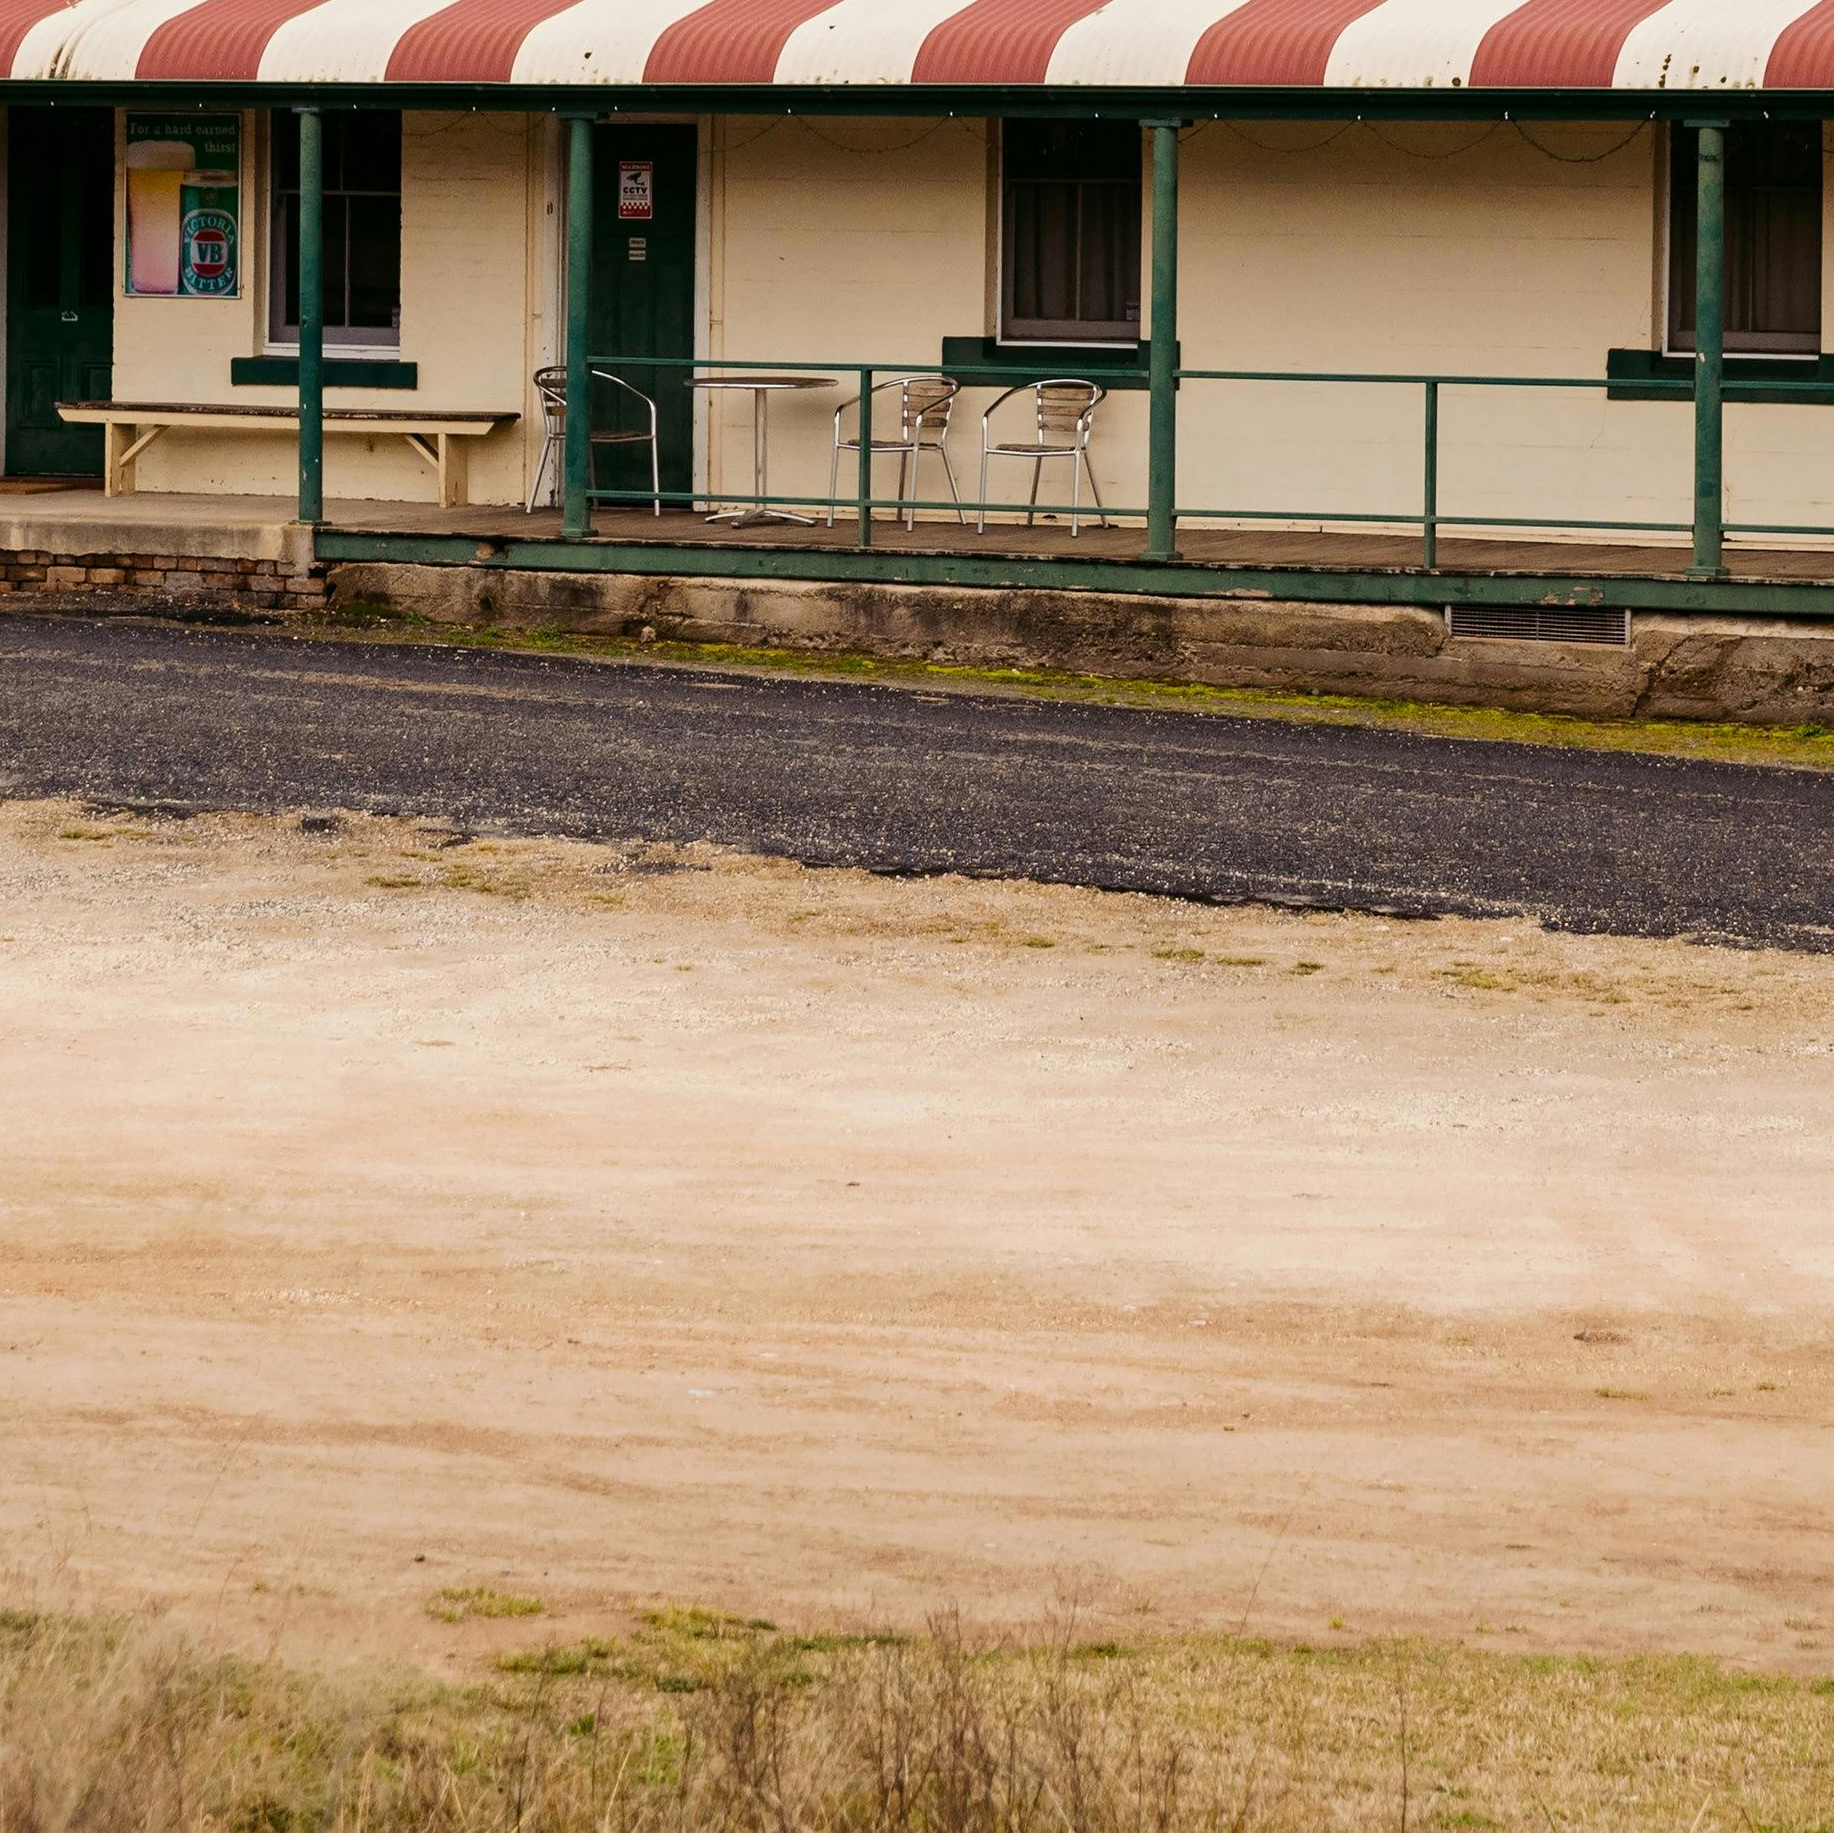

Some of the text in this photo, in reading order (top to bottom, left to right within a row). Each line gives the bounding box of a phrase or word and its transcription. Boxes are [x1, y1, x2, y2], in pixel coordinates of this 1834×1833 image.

[130, 123, 236, 135] For a hard earned
[204, 142, 236, 153] thirst
[623, 186, 648, 194] CCTV
[184, 215, 236, 245] VICTORIA
[197, 242, 224, 263] VB
[184, 267, 234, 290] BITTER
